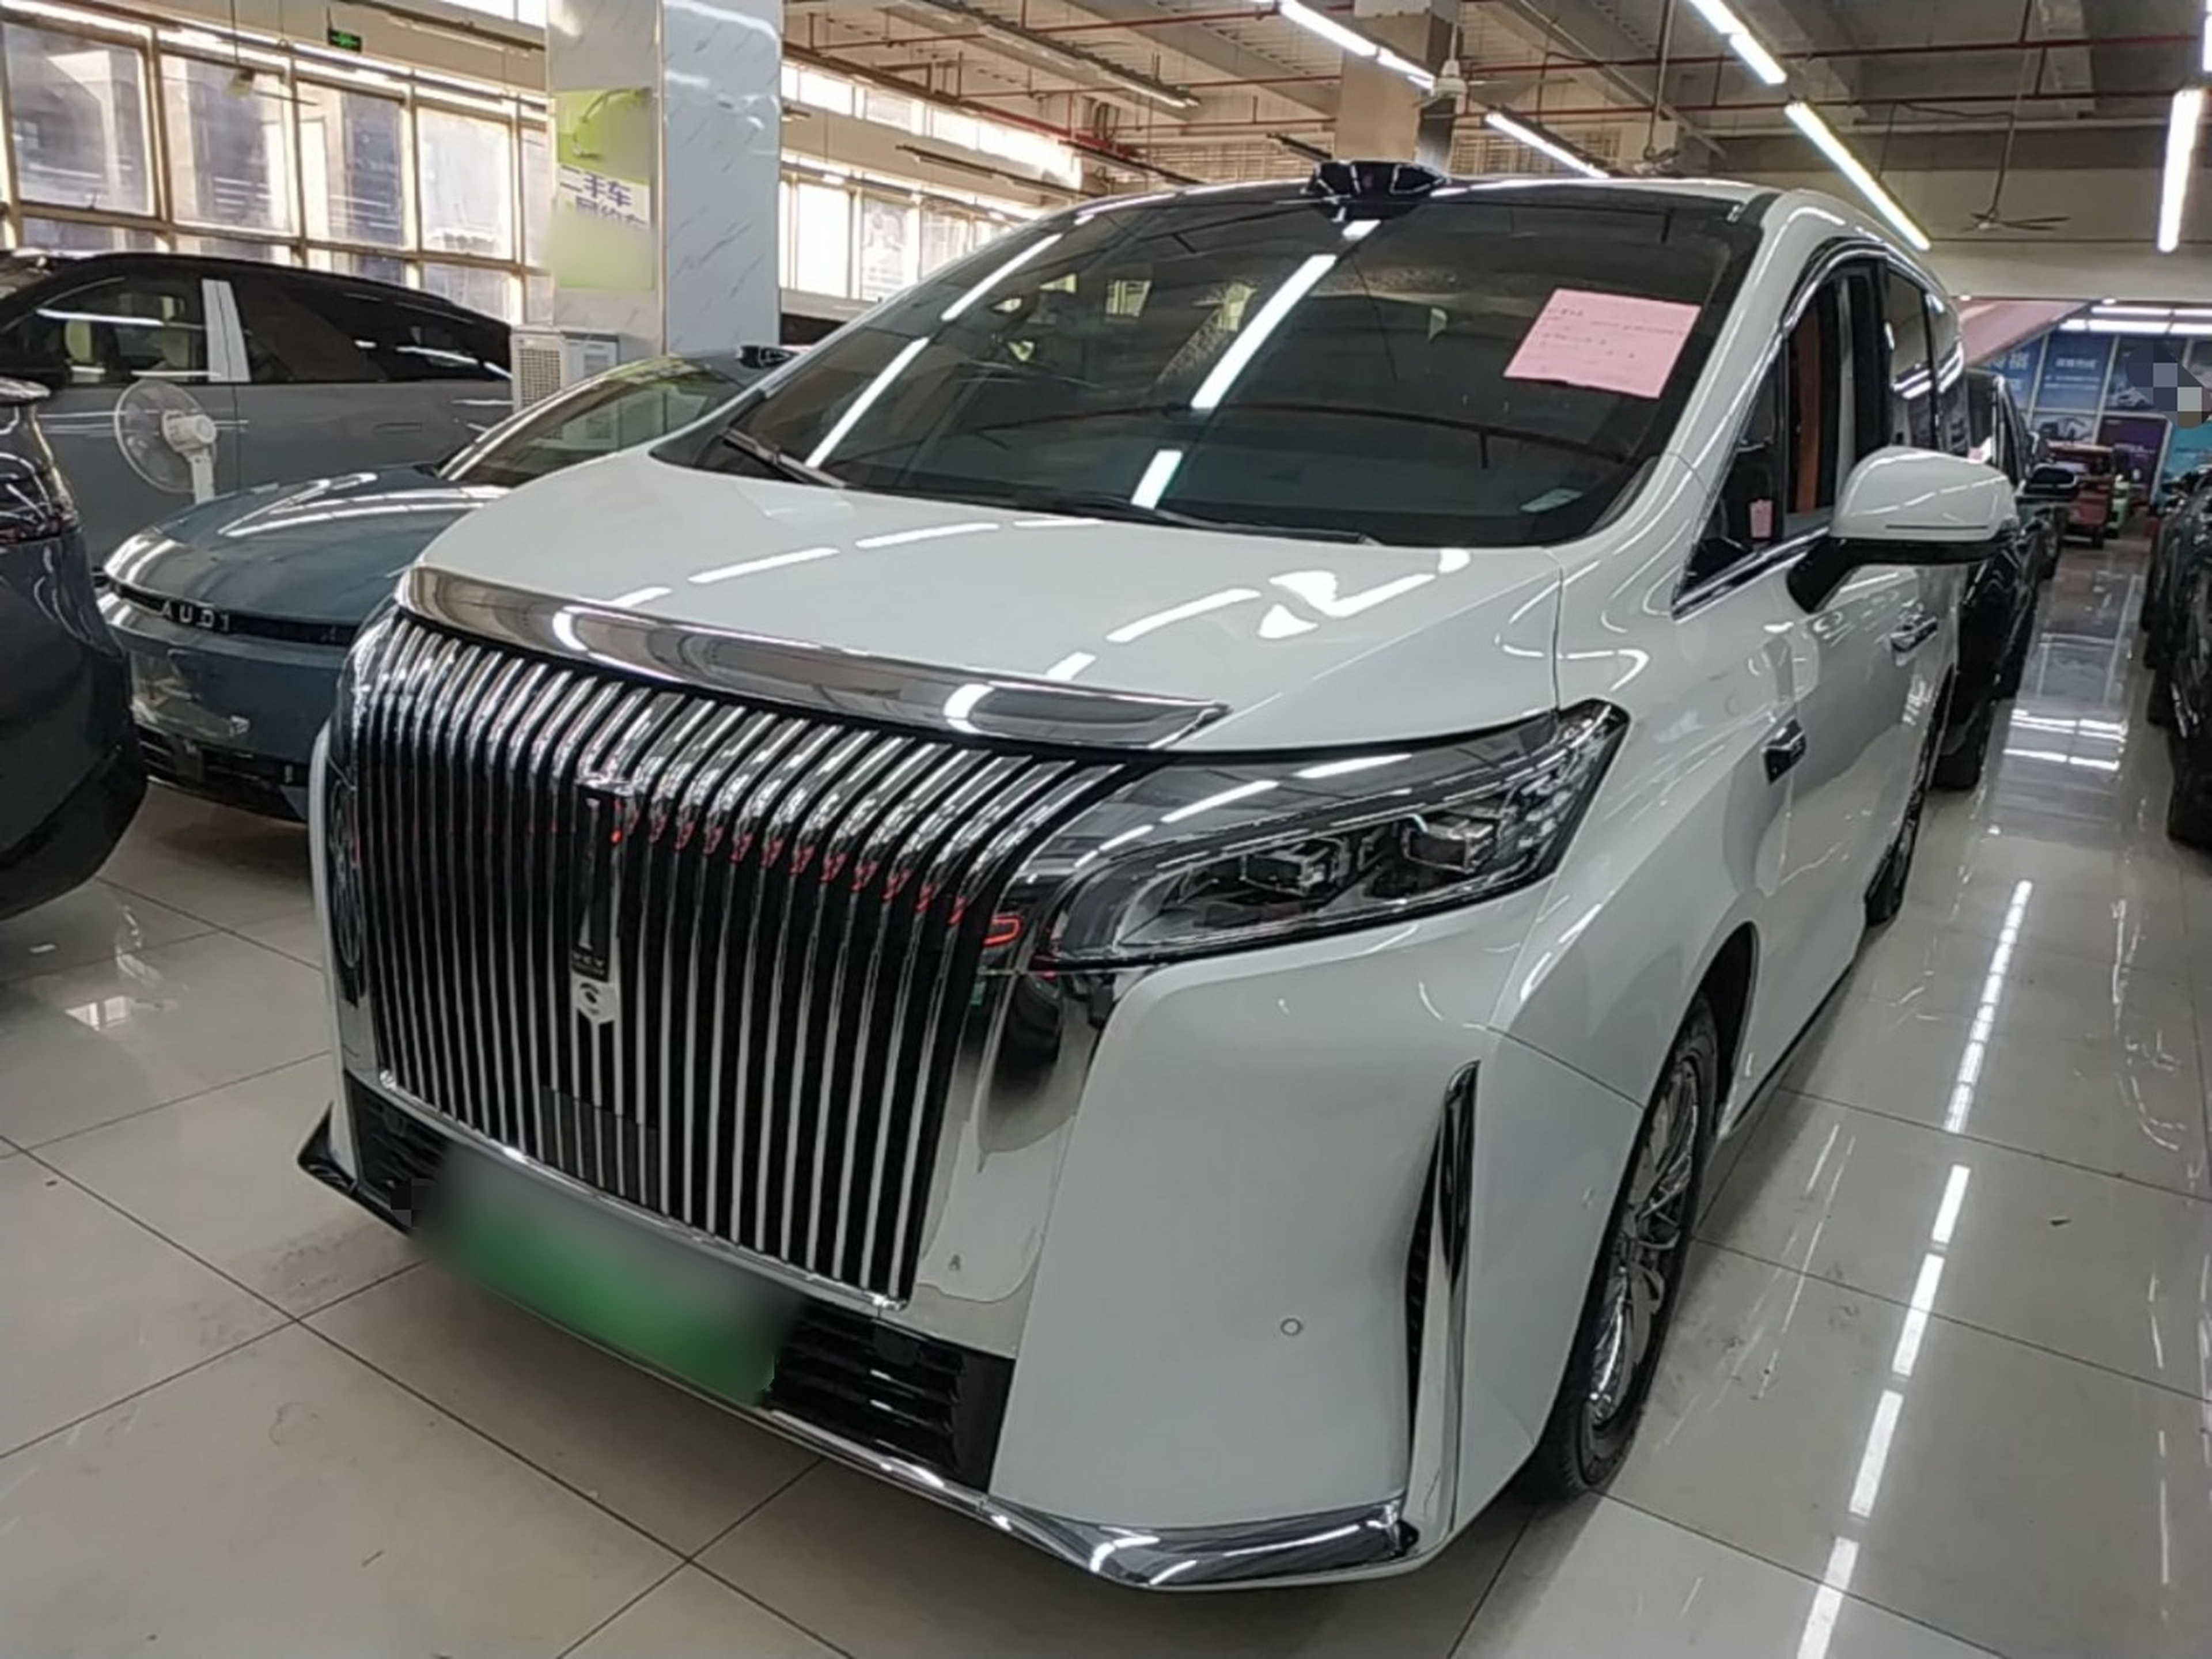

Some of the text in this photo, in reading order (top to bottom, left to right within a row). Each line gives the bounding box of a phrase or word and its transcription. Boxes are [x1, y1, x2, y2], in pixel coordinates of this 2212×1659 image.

[559, 165, 632, 207] 二手车
[161, 601, 229, 631] AUDI
